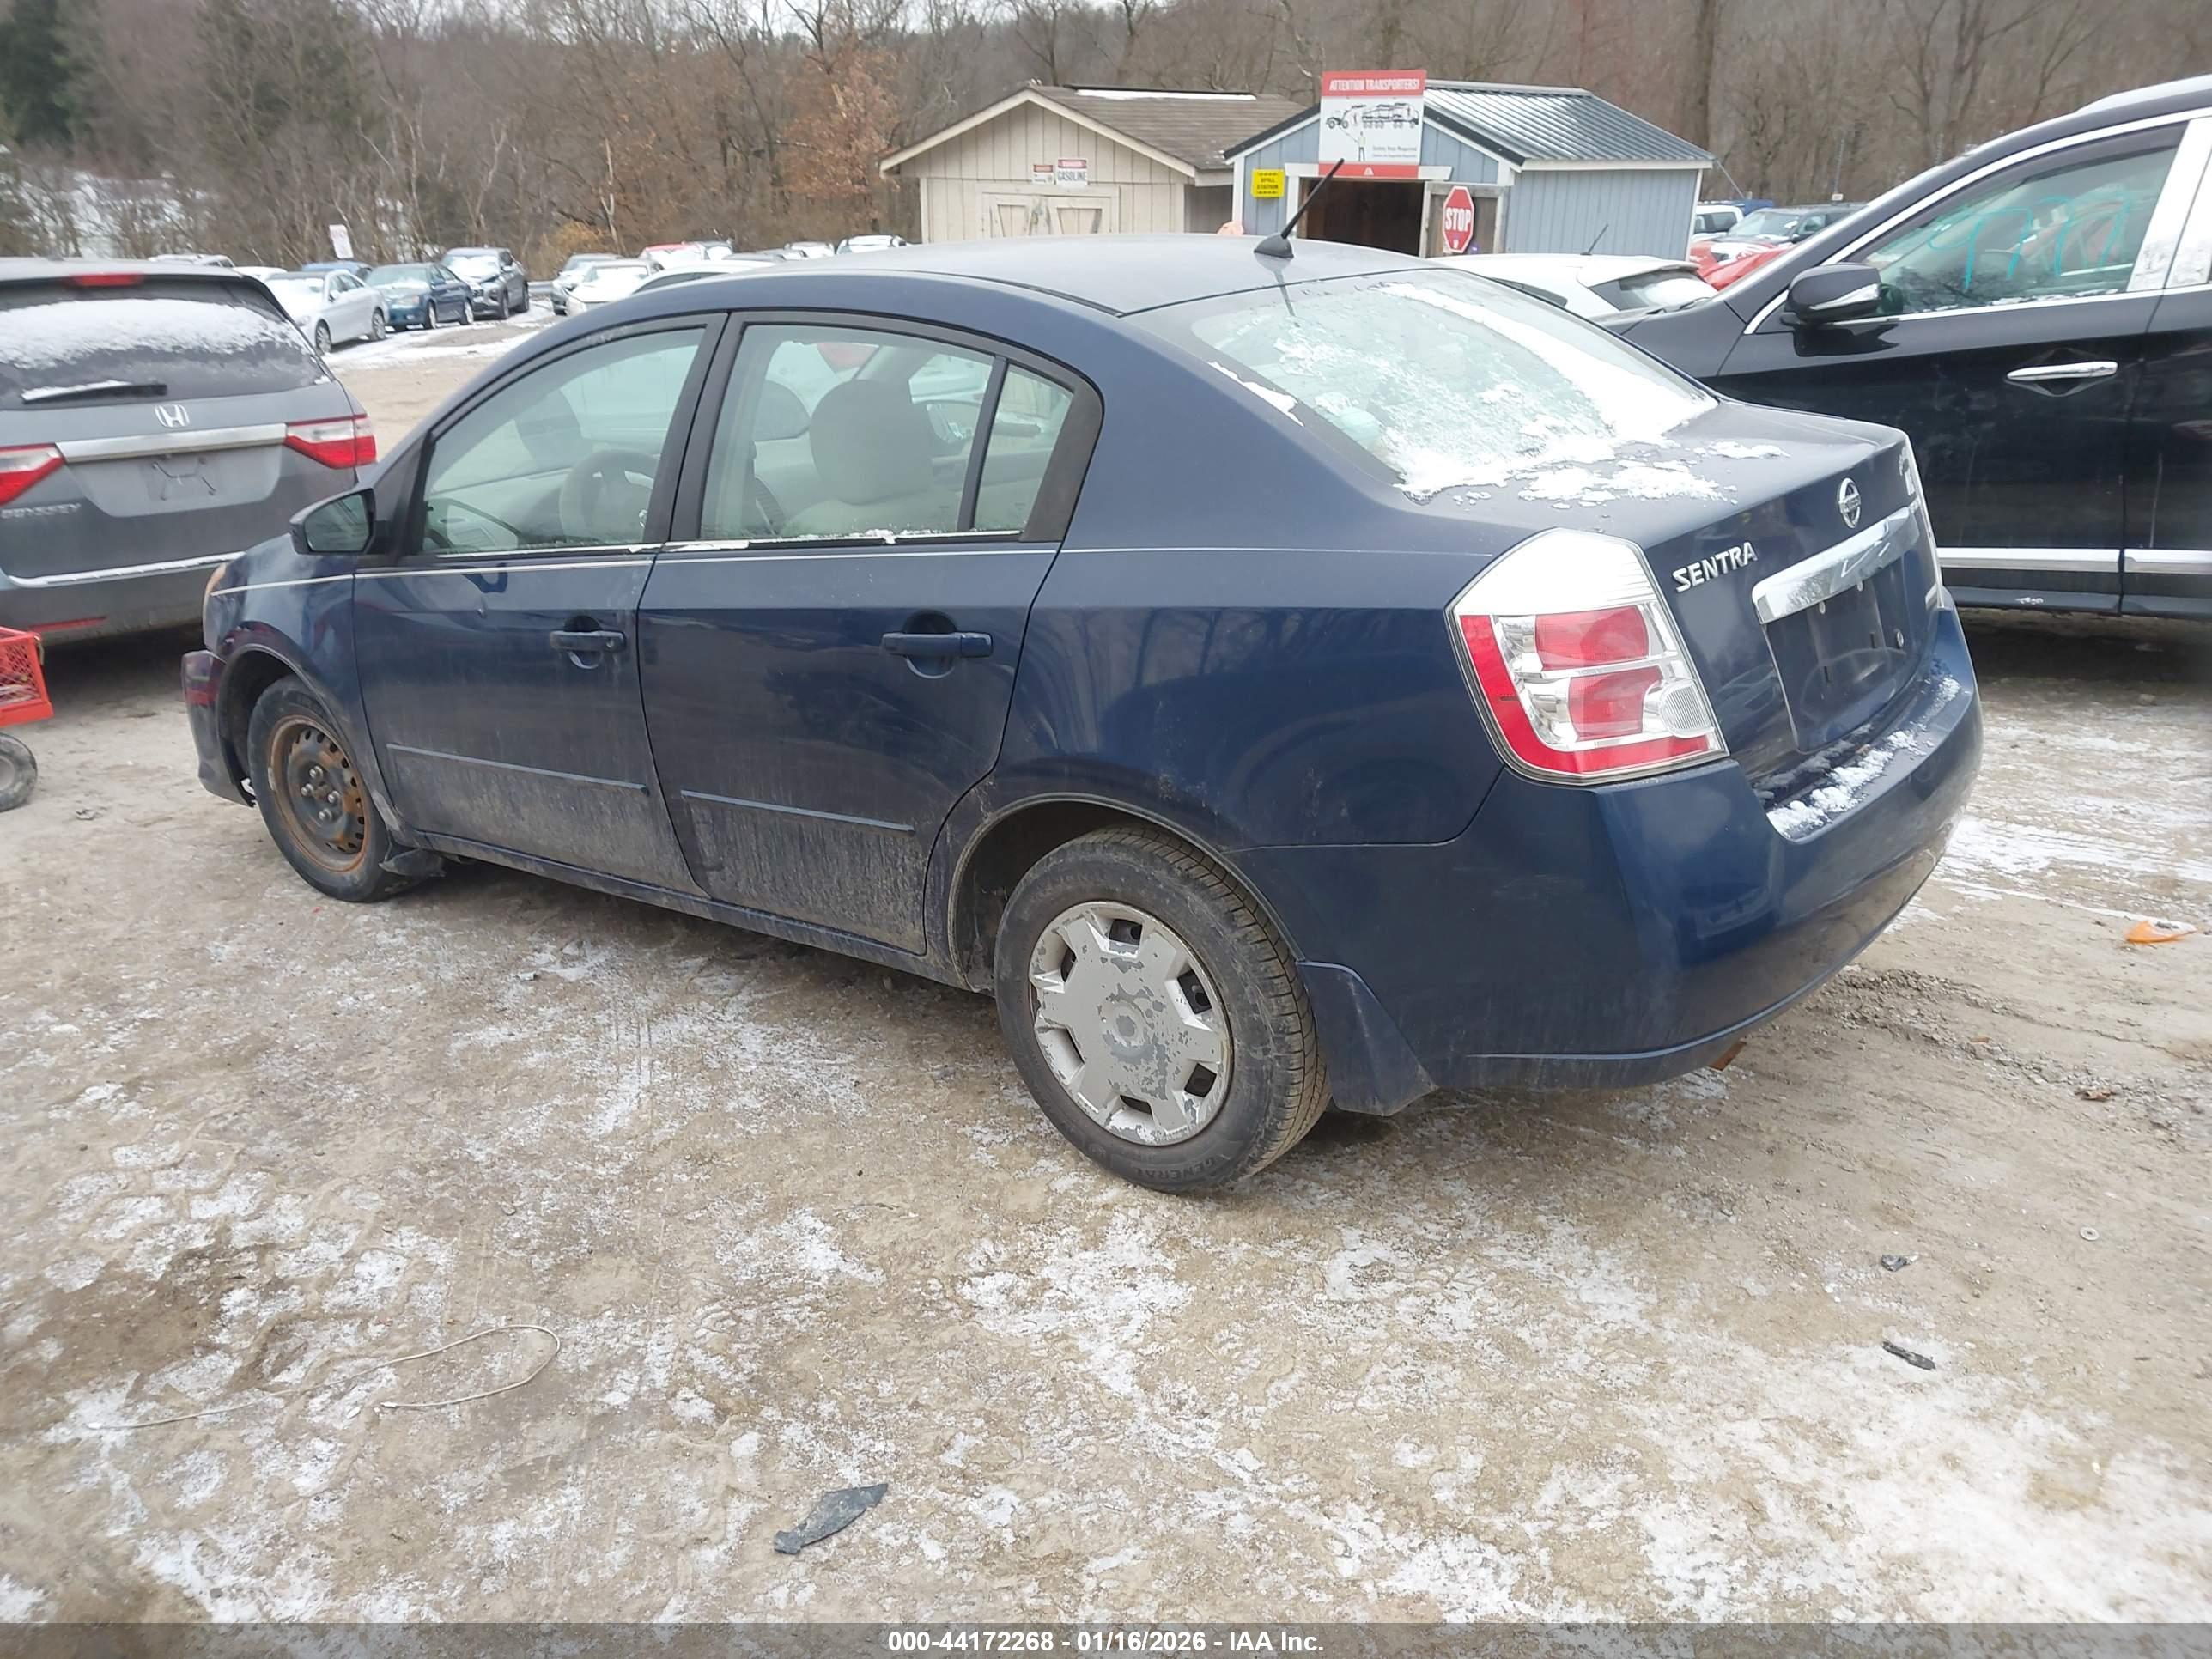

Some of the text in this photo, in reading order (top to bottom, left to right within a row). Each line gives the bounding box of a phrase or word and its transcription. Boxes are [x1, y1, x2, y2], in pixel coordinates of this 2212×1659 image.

[1329, 78, 1420, 91] ATTENTION TRANSPORTERS!
[1057, 170, 1086, 181] GASOLINE
[1445, 206, 1471, 233] STOP
[1672, 541, 1759, 593] SENTRA
